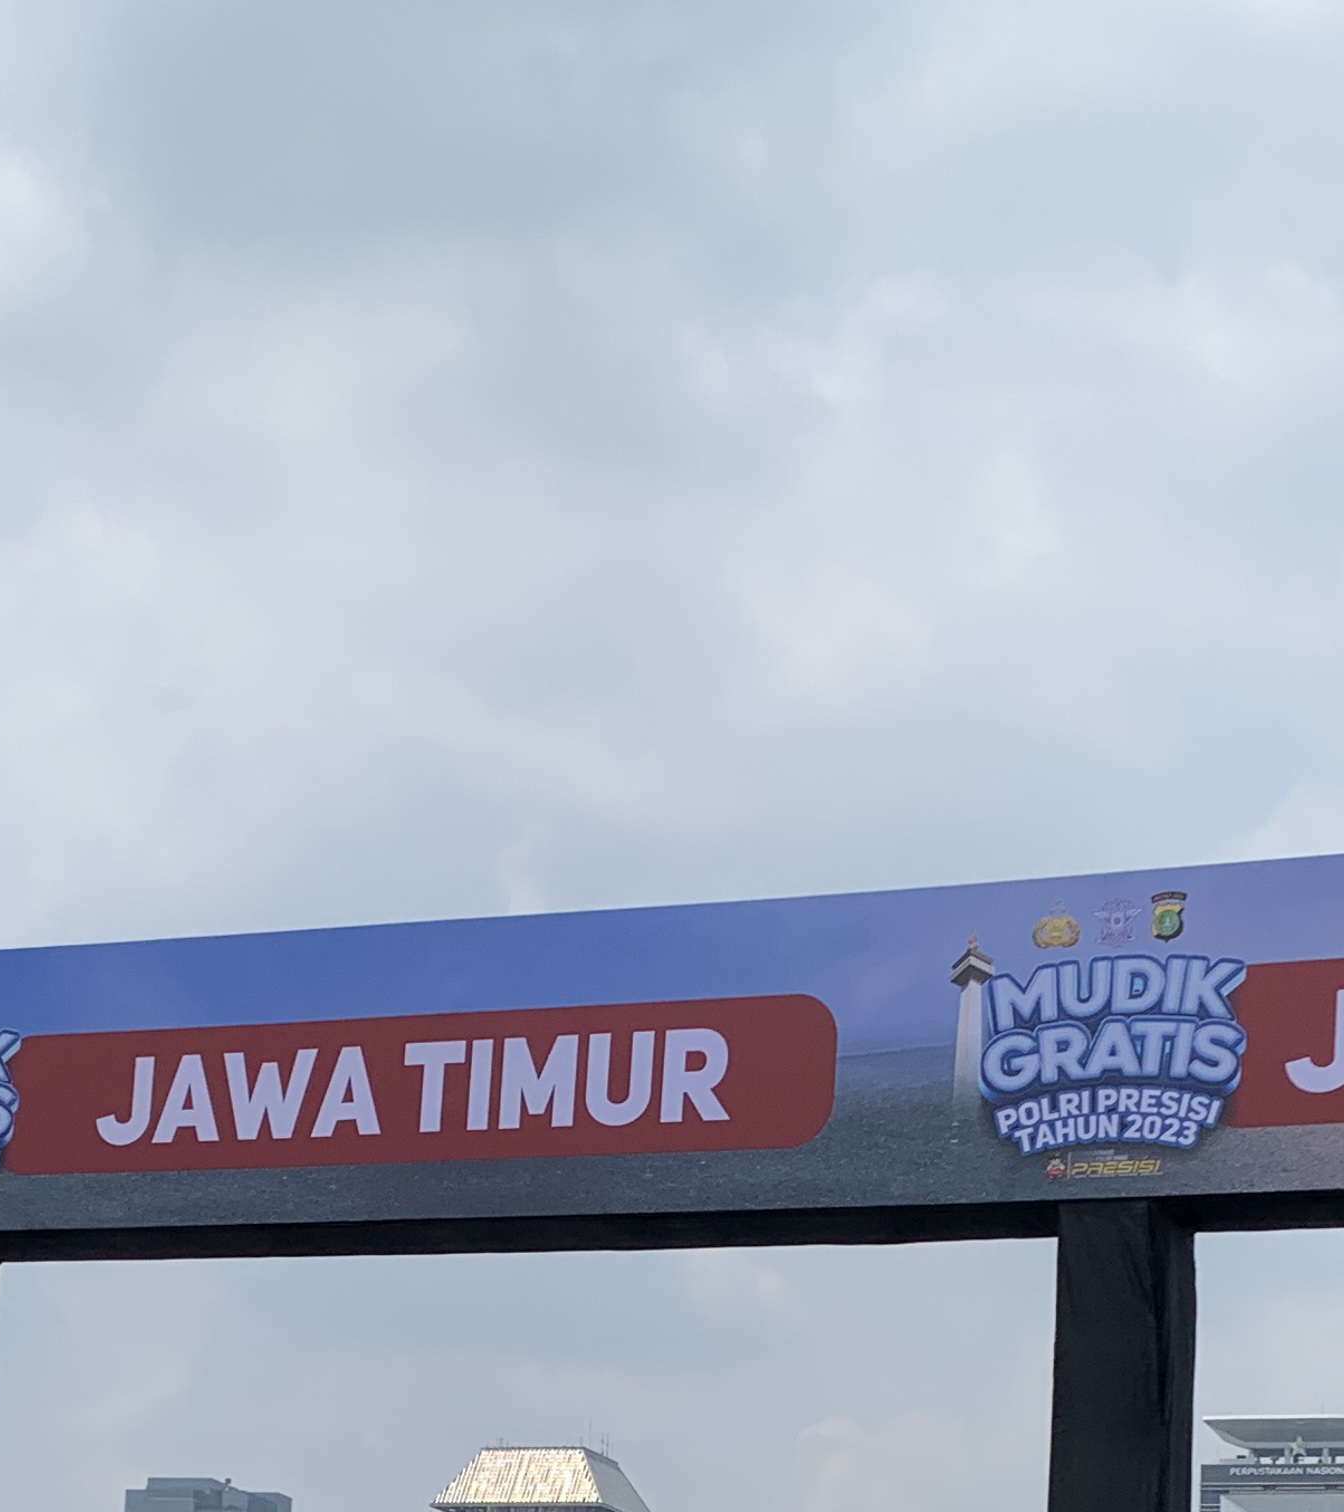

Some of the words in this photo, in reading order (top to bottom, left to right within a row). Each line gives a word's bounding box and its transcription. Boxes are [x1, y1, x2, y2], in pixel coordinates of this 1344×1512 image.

[991, 954, 1245, 1032] MUDIK
[981, 1016, 1245, 1094] GRATIS
[95, 1045, 382, 1147] JAWA
[403, 1027, 731, 1134] TIMUR
[996, 1091, 1090, 1135] POLRI
[1098, 1087, 1222, 1125] PRESISI
[1014, 1114, 1120, 1154] TAHUN
[1123, 1113, 1199, 1145] 2023
[1229, 1466, 1304, 1476] PERPUSTAKAAN
